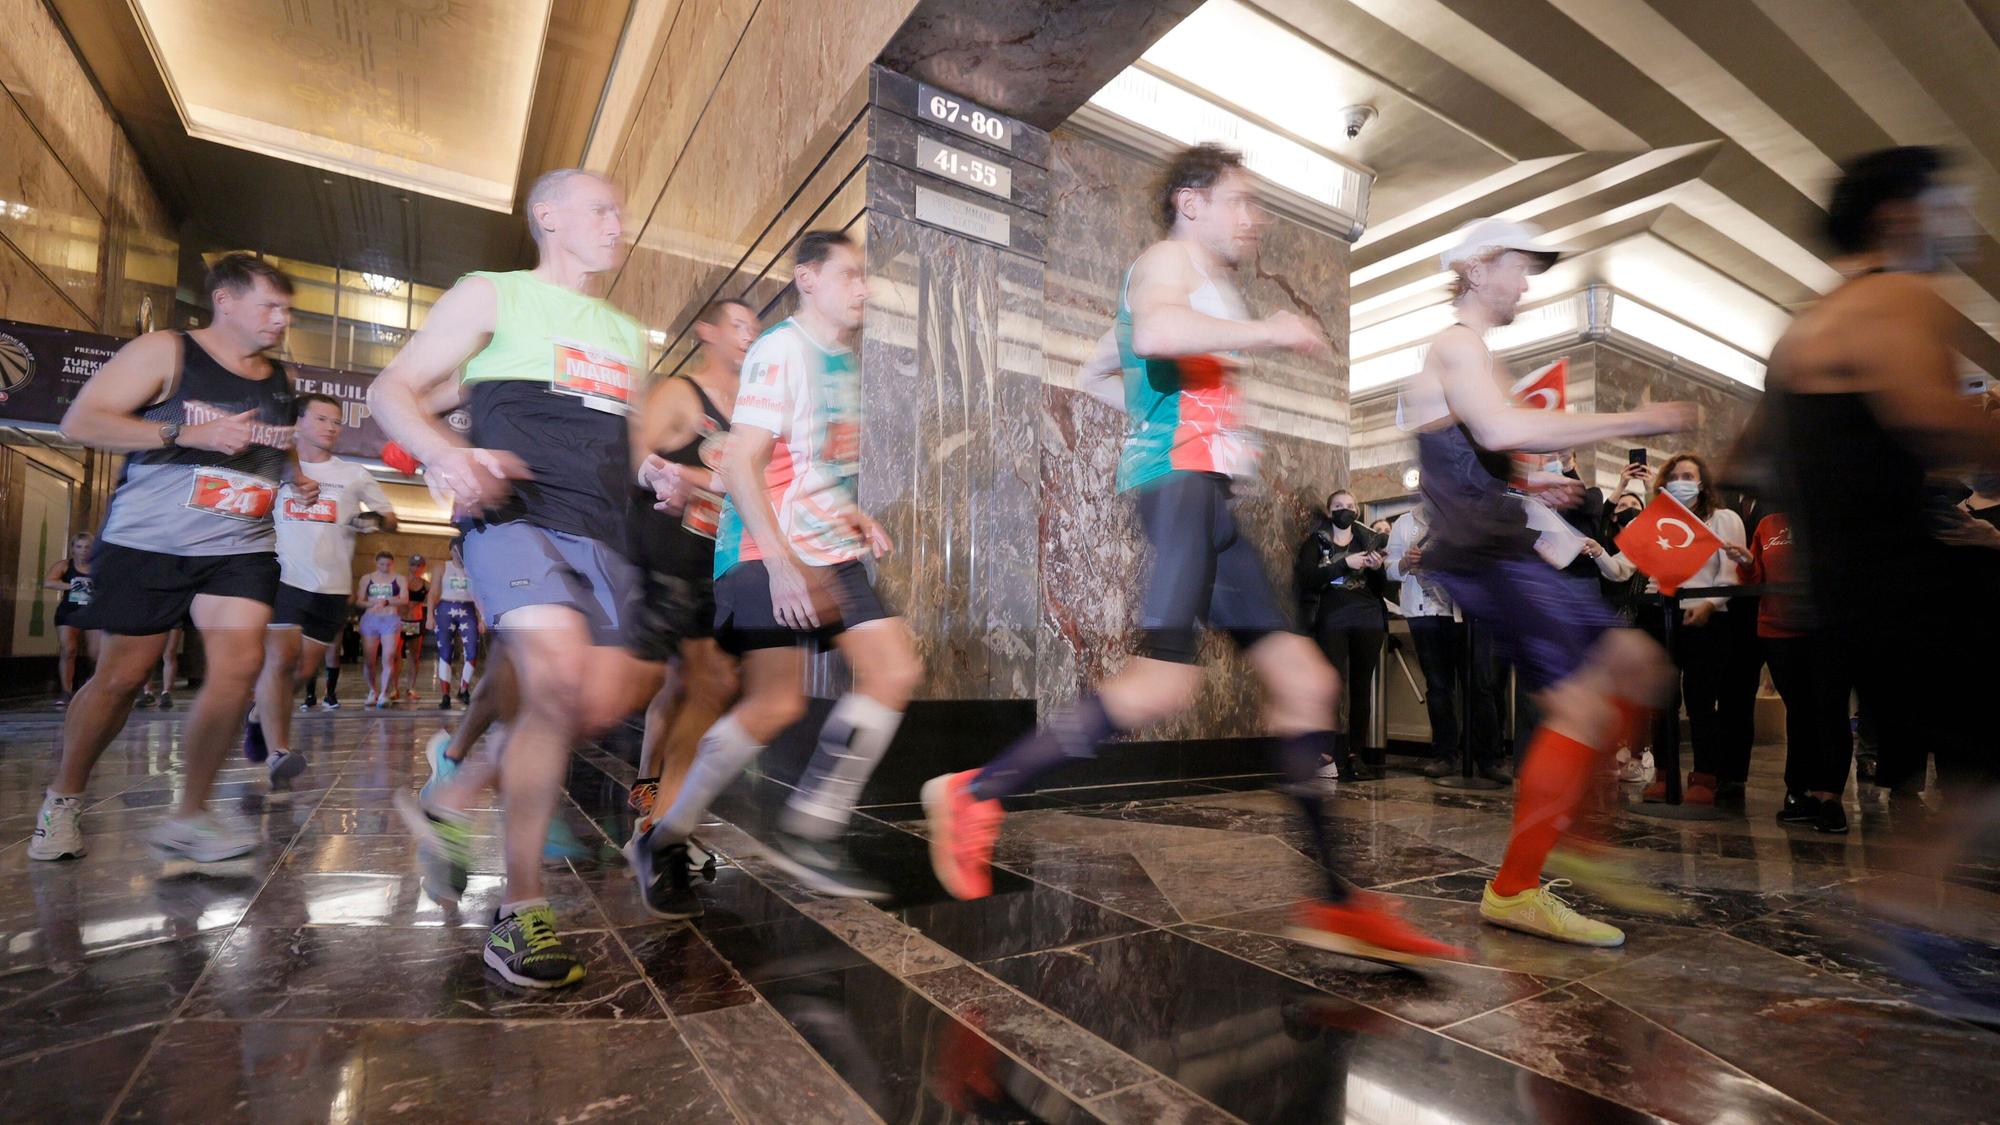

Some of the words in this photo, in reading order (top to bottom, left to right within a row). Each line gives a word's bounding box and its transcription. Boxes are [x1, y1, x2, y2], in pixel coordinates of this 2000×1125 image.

[930, 96, 1004, 140] 67-80
[933, 149, 997, 188] 41-55
[295, 378, 316, 394] TE
[322, 381, 366, 400] BUIL
[566, 358, 627, 390] MARK
[215, 487, 252, 514] 24
